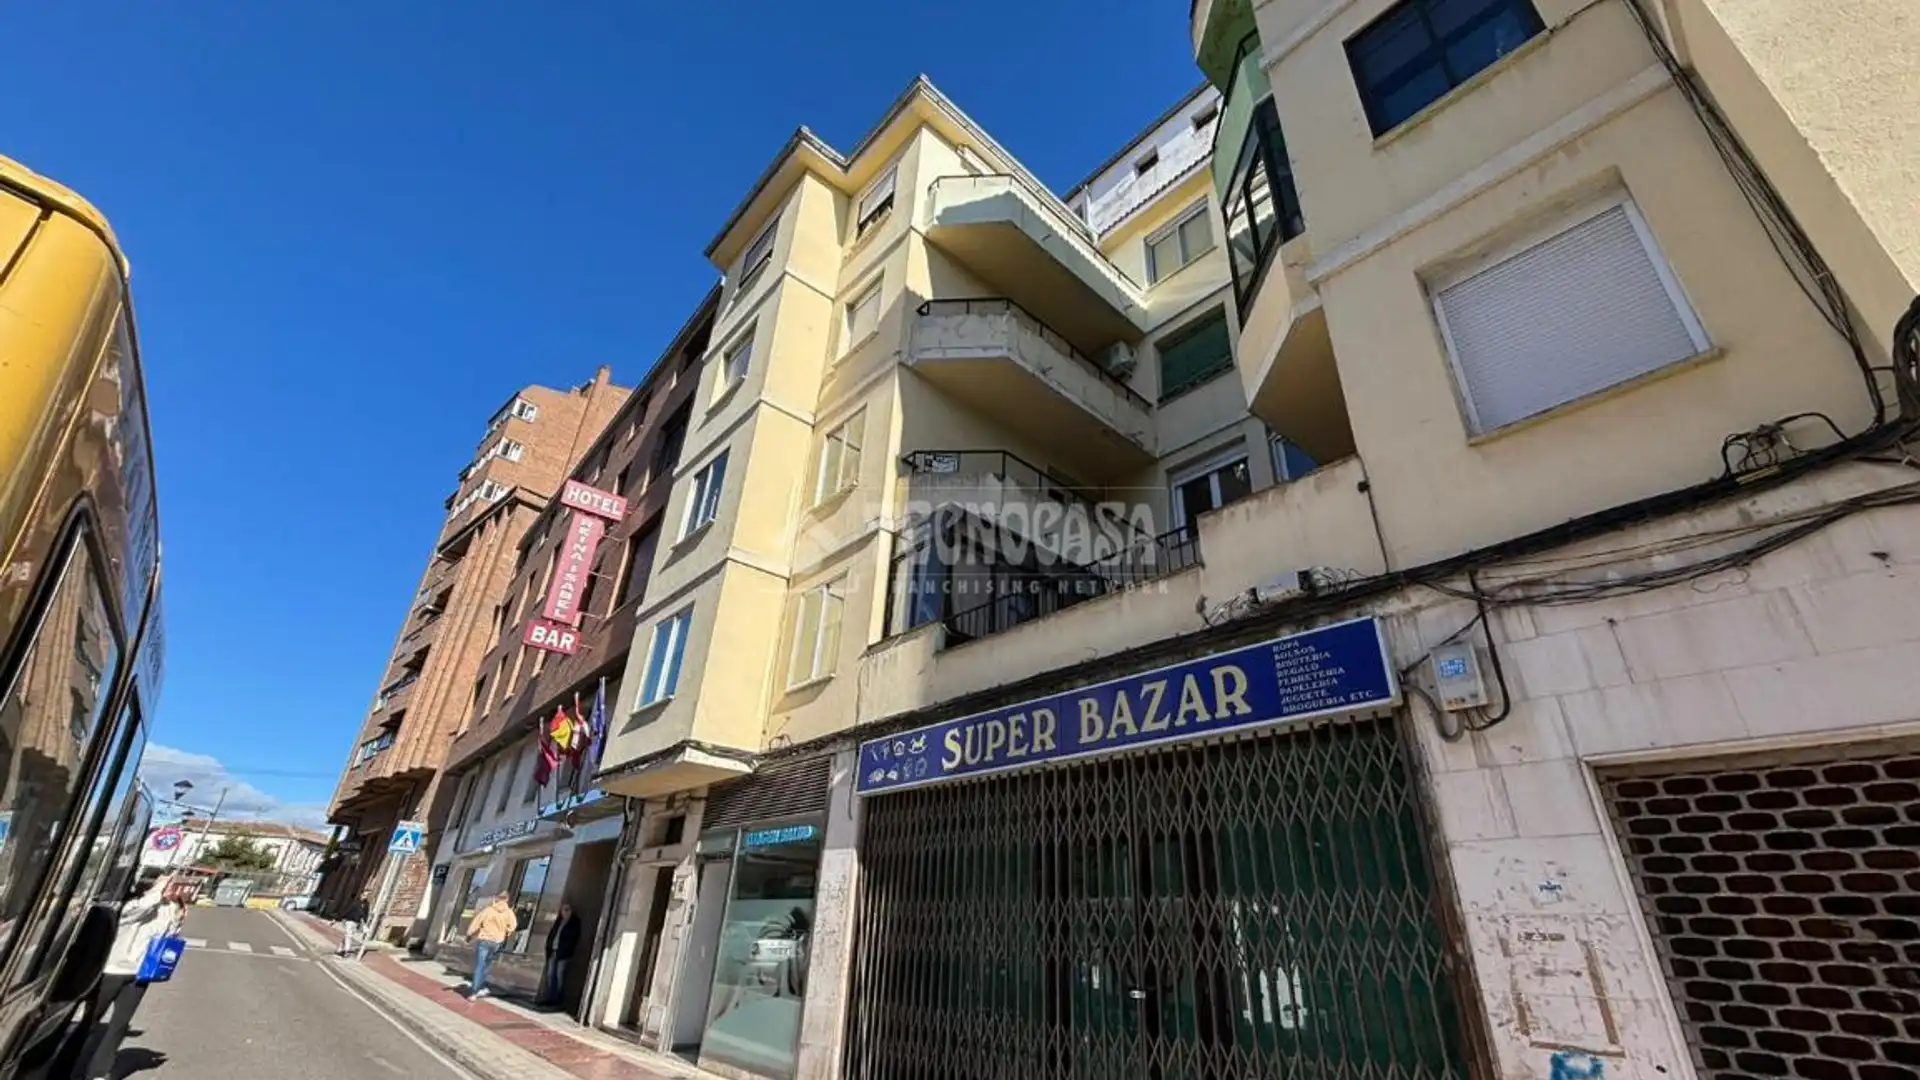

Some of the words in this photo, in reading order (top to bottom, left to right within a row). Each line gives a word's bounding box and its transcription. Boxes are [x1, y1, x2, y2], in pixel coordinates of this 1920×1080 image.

[567, 485, 622, 516] HOTEL
[554, 566, 577, 620] ISABEL
[530, 626, 576, 651] BAR
[1272, 640, 1300, 653] ROPA
[1274, 646, 1316, 661] BOLSOS
[942, 707, 1057, 771] SUPER
[1078, 665, 1252, 744] BAZAR
